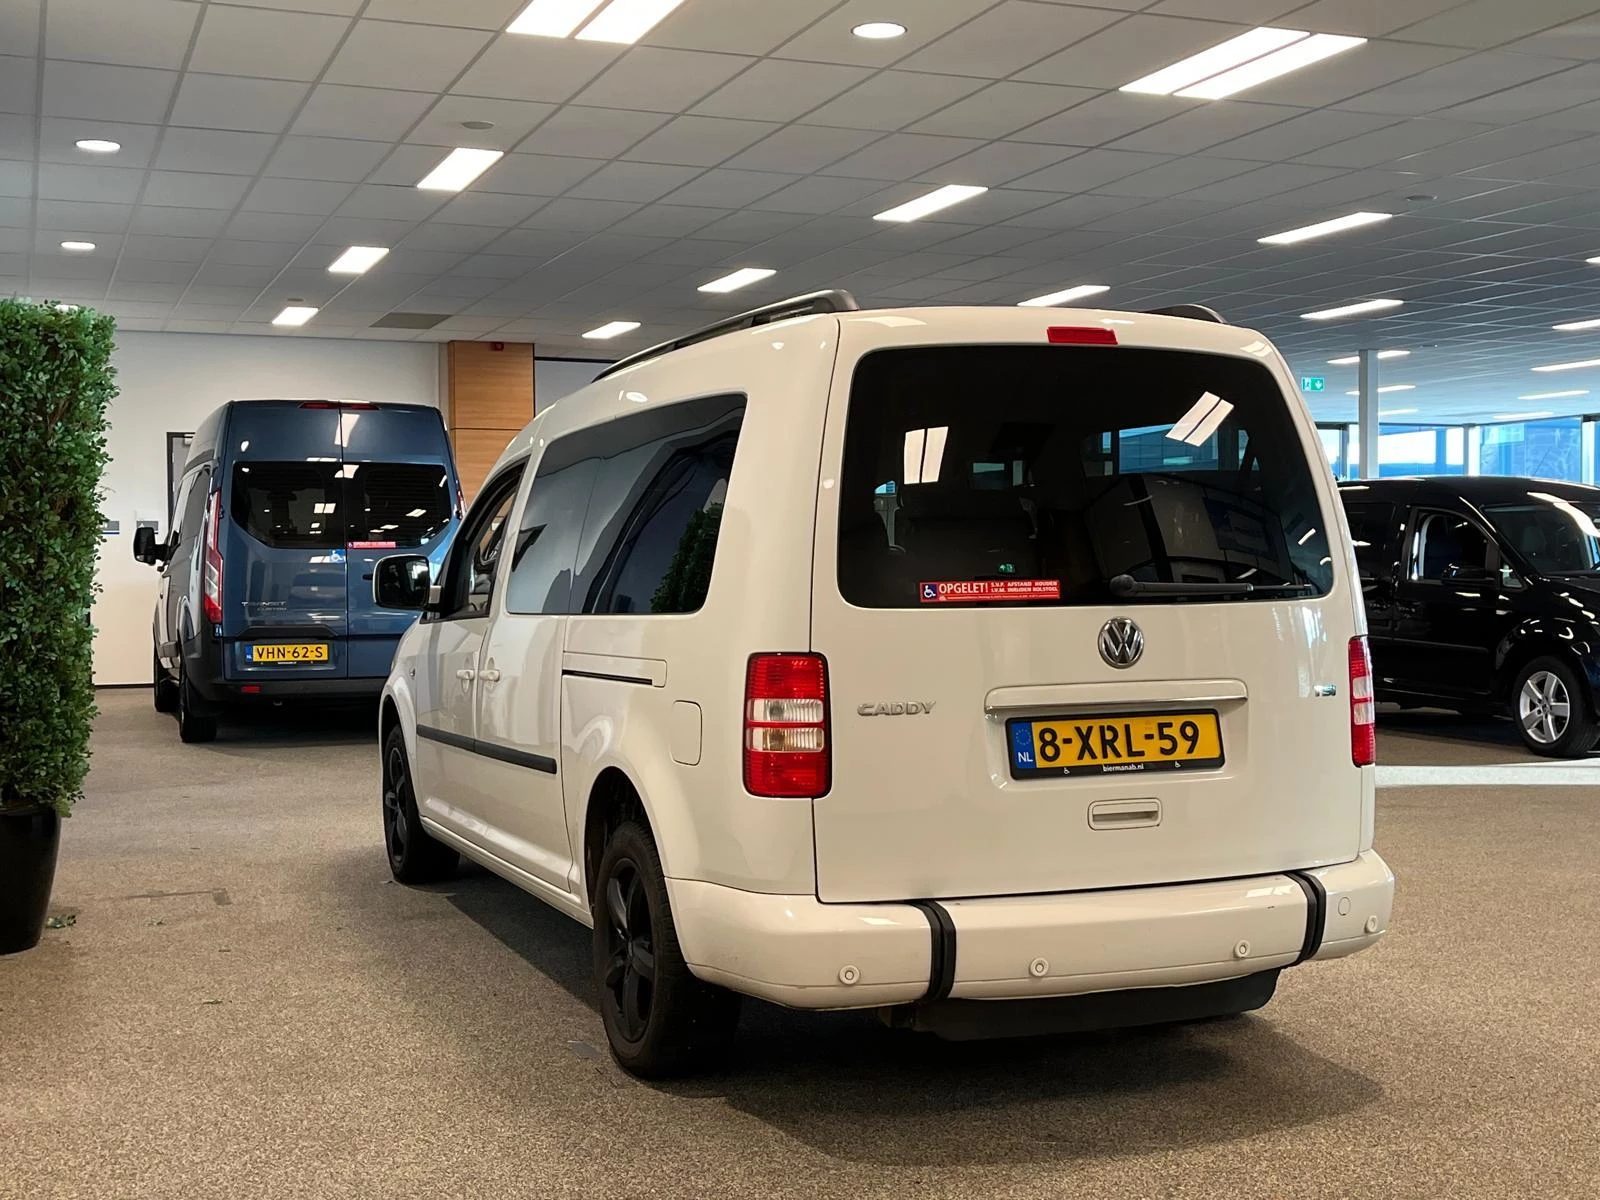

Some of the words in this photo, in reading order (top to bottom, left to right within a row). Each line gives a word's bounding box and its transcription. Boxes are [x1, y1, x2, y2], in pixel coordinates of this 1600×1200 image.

[938, 582, 989, 594] OPGELET!
[256, 646, 323, 659] VHN-62-S
[857, 700, 936, 716] CADDY
[1038, 720, 1200, 763] 8-XRL-59
[1018, 752, 1033, 763] NL
[1102, 763, 1144, 772] biermanab.nl
